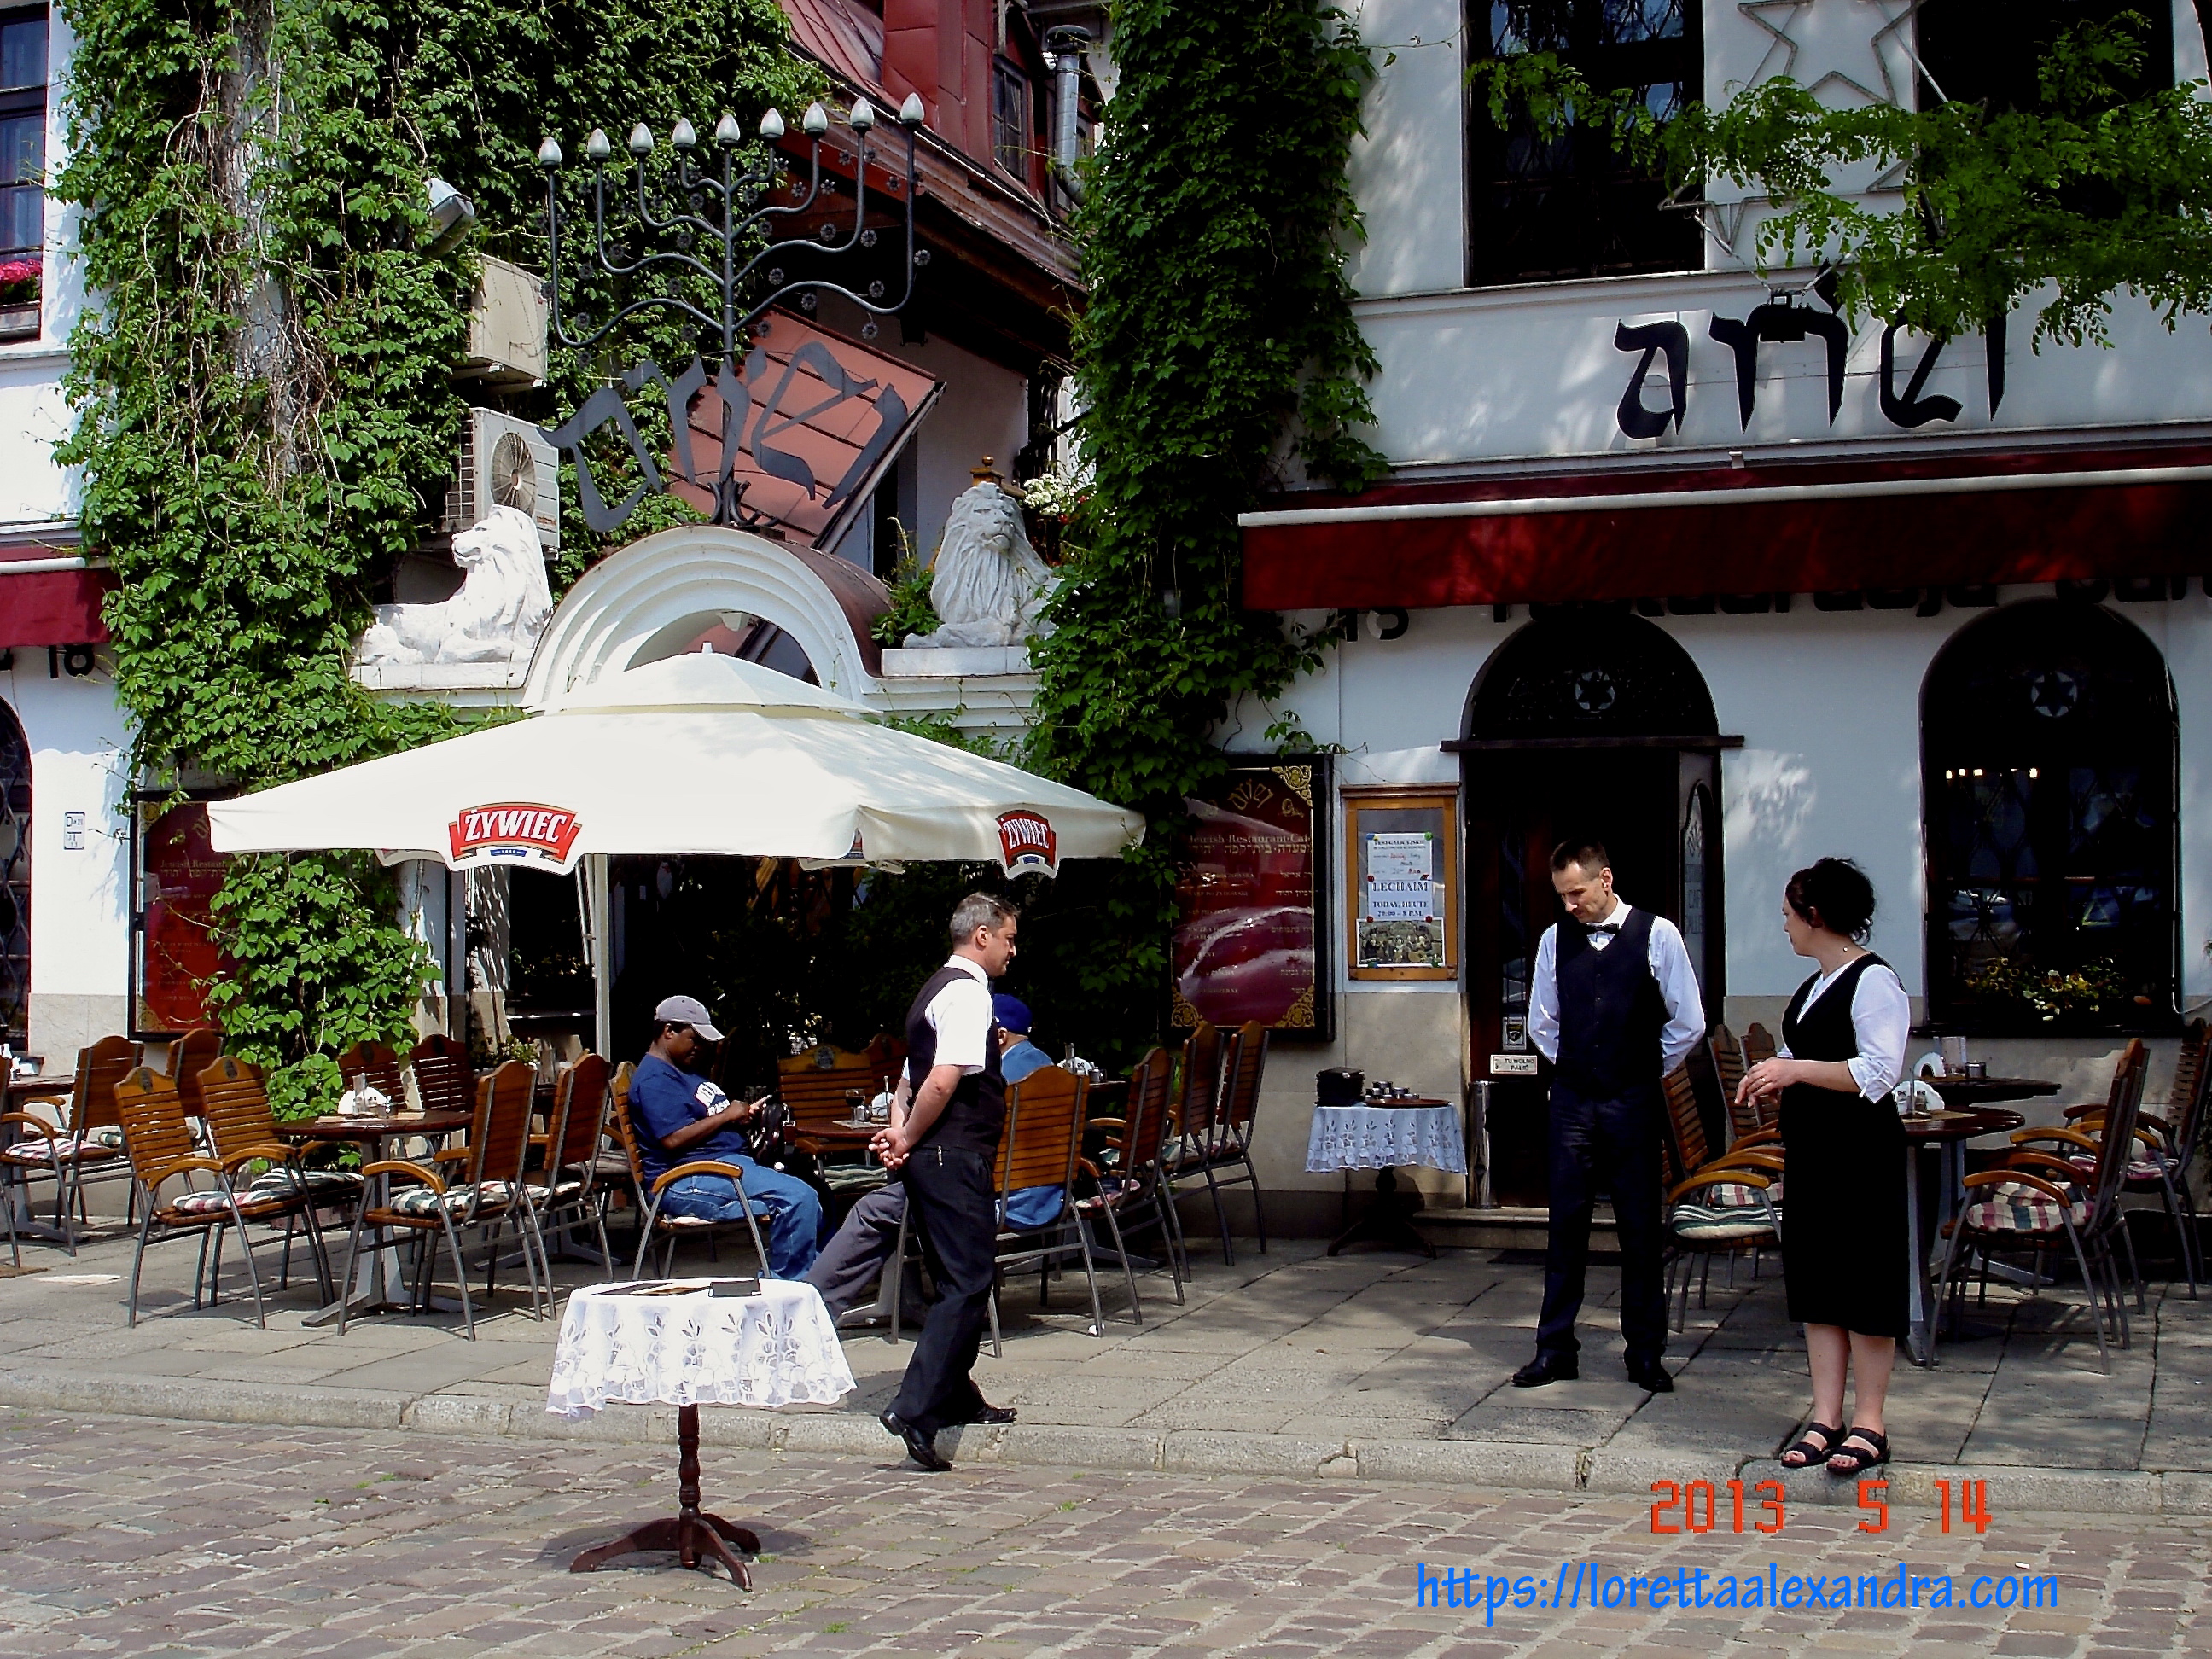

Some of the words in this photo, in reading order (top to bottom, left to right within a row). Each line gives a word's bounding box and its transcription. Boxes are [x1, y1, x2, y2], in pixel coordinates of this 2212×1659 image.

[464, 809, 568, 843] ŻYWIEC
[1000, 818, 1050, 849] ŻYWIEC
[1372, 882, 1428, 892] LECHAIM
